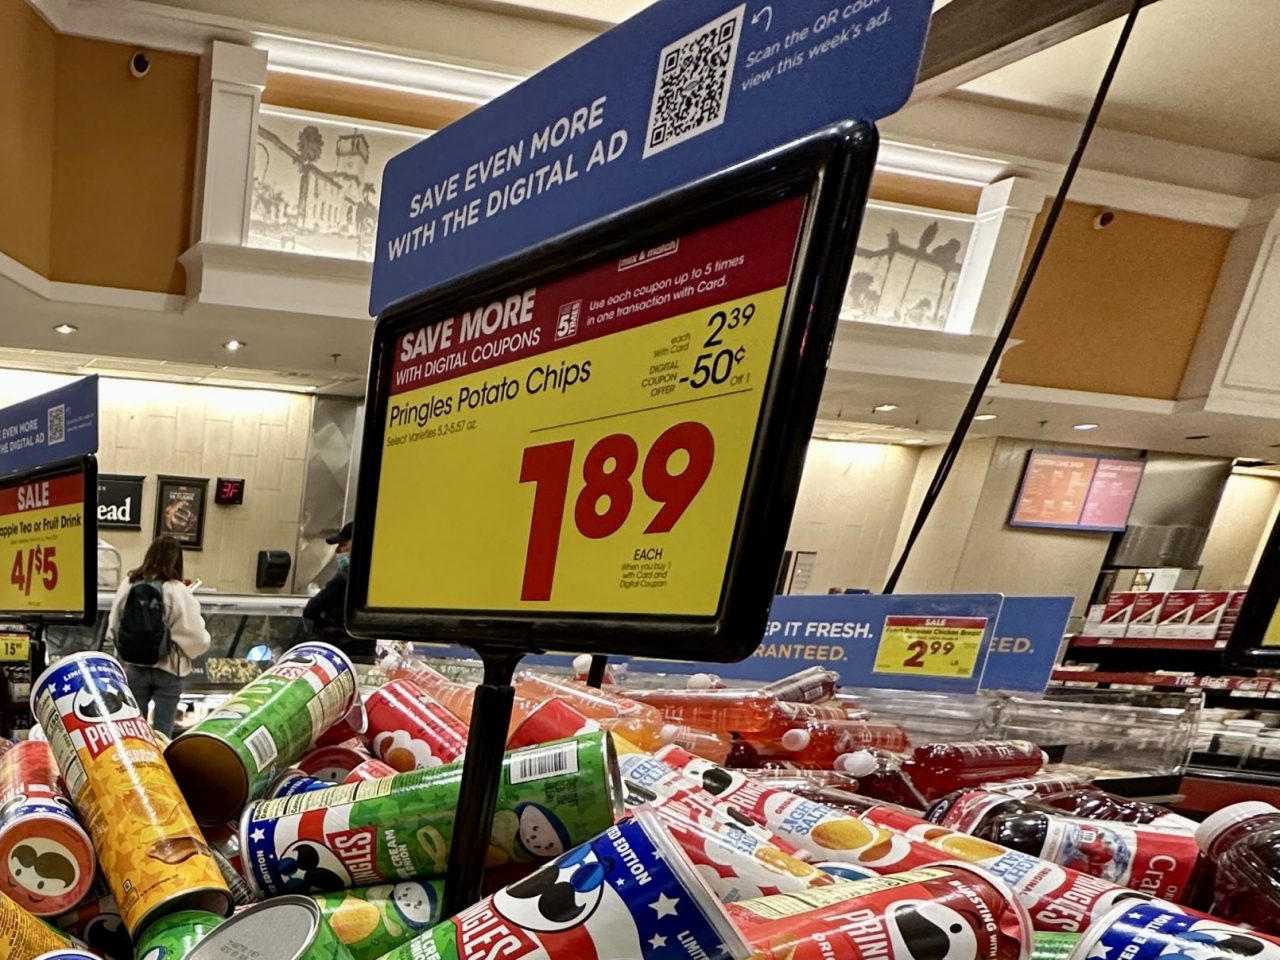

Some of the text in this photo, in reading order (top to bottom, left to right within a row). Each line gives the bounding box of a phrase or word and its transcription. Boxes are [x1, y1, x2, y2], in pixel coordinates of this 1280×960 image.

[741, 6, 893, 91] view this week's ad.
[746, 8, 839, 68] Scan the QR
[409, 96, 608, 219] SAVE EVEN MORE
[387, 128, 629, 261] WITH THE DIGITAL AD
[589, 254, 745, 311] Use each coupon up to 5 times
[587, 284, 695, 327] in one transaction with
[400, 287, 537, 362] SAVE MORE
[557, 314, 571, 337] 5
[395, 326, 541, 386] WITH DIGITAL COUPONS
[649, 360, 679, 375] DIGITAL
[389, 360, 592, 428] Pringles Potato Chips
[641, 372, 678, 388] COUPON
[650, 384, 676, 398] OFFER
[2, 426, 19, 440] EVEN
[20, 418, 38, 434] MORE
[10, 435, 34, 452] DIGITAL
[35, 432, 45, 444] AD
[17, 481, 50, 511] SALE
[98, 497, 131, 522] ead
[20, 521, 32, 534] Tea
[33, 521, 42, 532] or
[43, 515, 59, 530] Fruit
[61, 513, 81, 526] Drink
[633, 547, 664, 561] EACH
[783, 621, 873, 639] IT FRESH.
[924, 618, 946, 626] SALE
[613, 836, 653, 886] EDITION
[949, 880, 998, 957] BURSTING WITH
